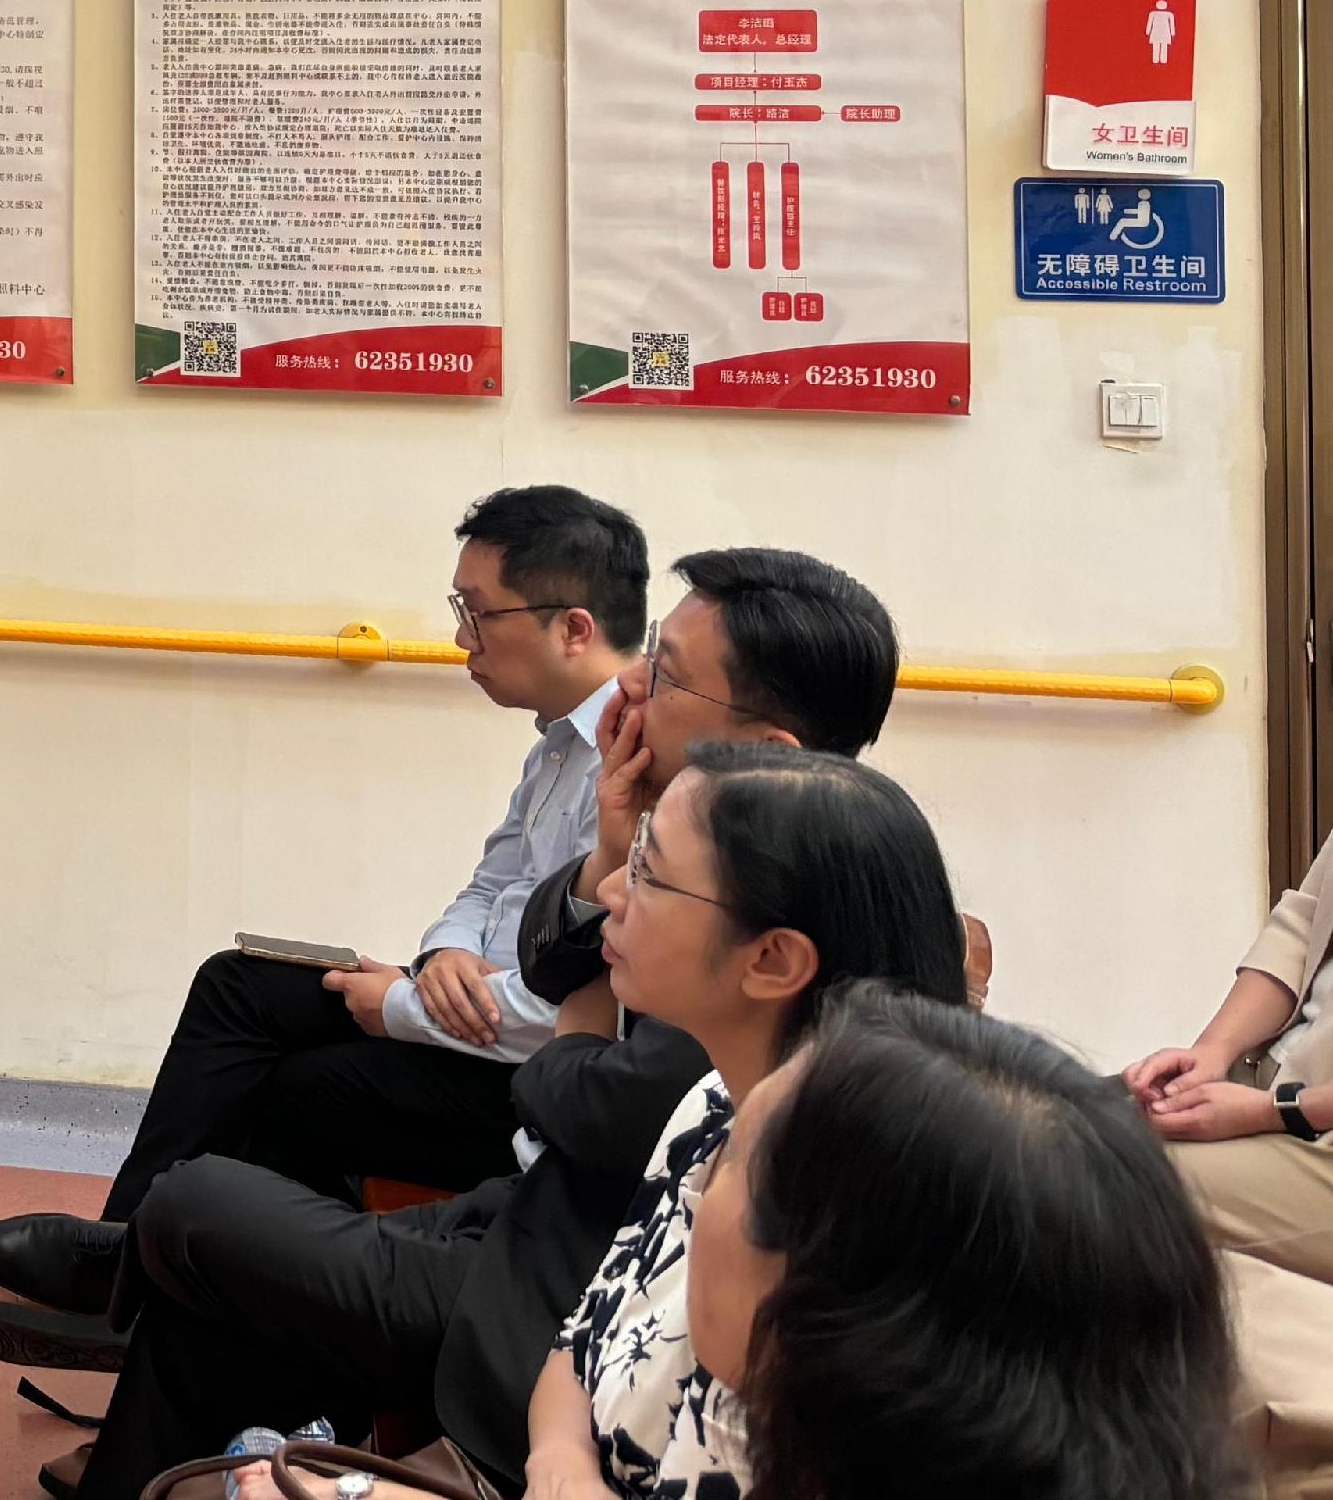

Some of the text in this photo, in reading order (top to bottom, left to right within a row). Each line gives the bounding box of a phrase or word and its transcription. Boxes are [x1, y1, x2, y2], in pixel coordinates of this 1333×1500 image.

[1091, 123, 1189, 148] 女卫生间
[1086, 150, 1188, 164] Women's Bathroom
[1037, 253, 1206, 279] 无障碍卫生间
[1035, 276, 1207, 292] Accessible Restroom
[274, 351, 474, 374] 服务热线： 62351930
[719, 365, 937, 389] 服务热线： 62351930
